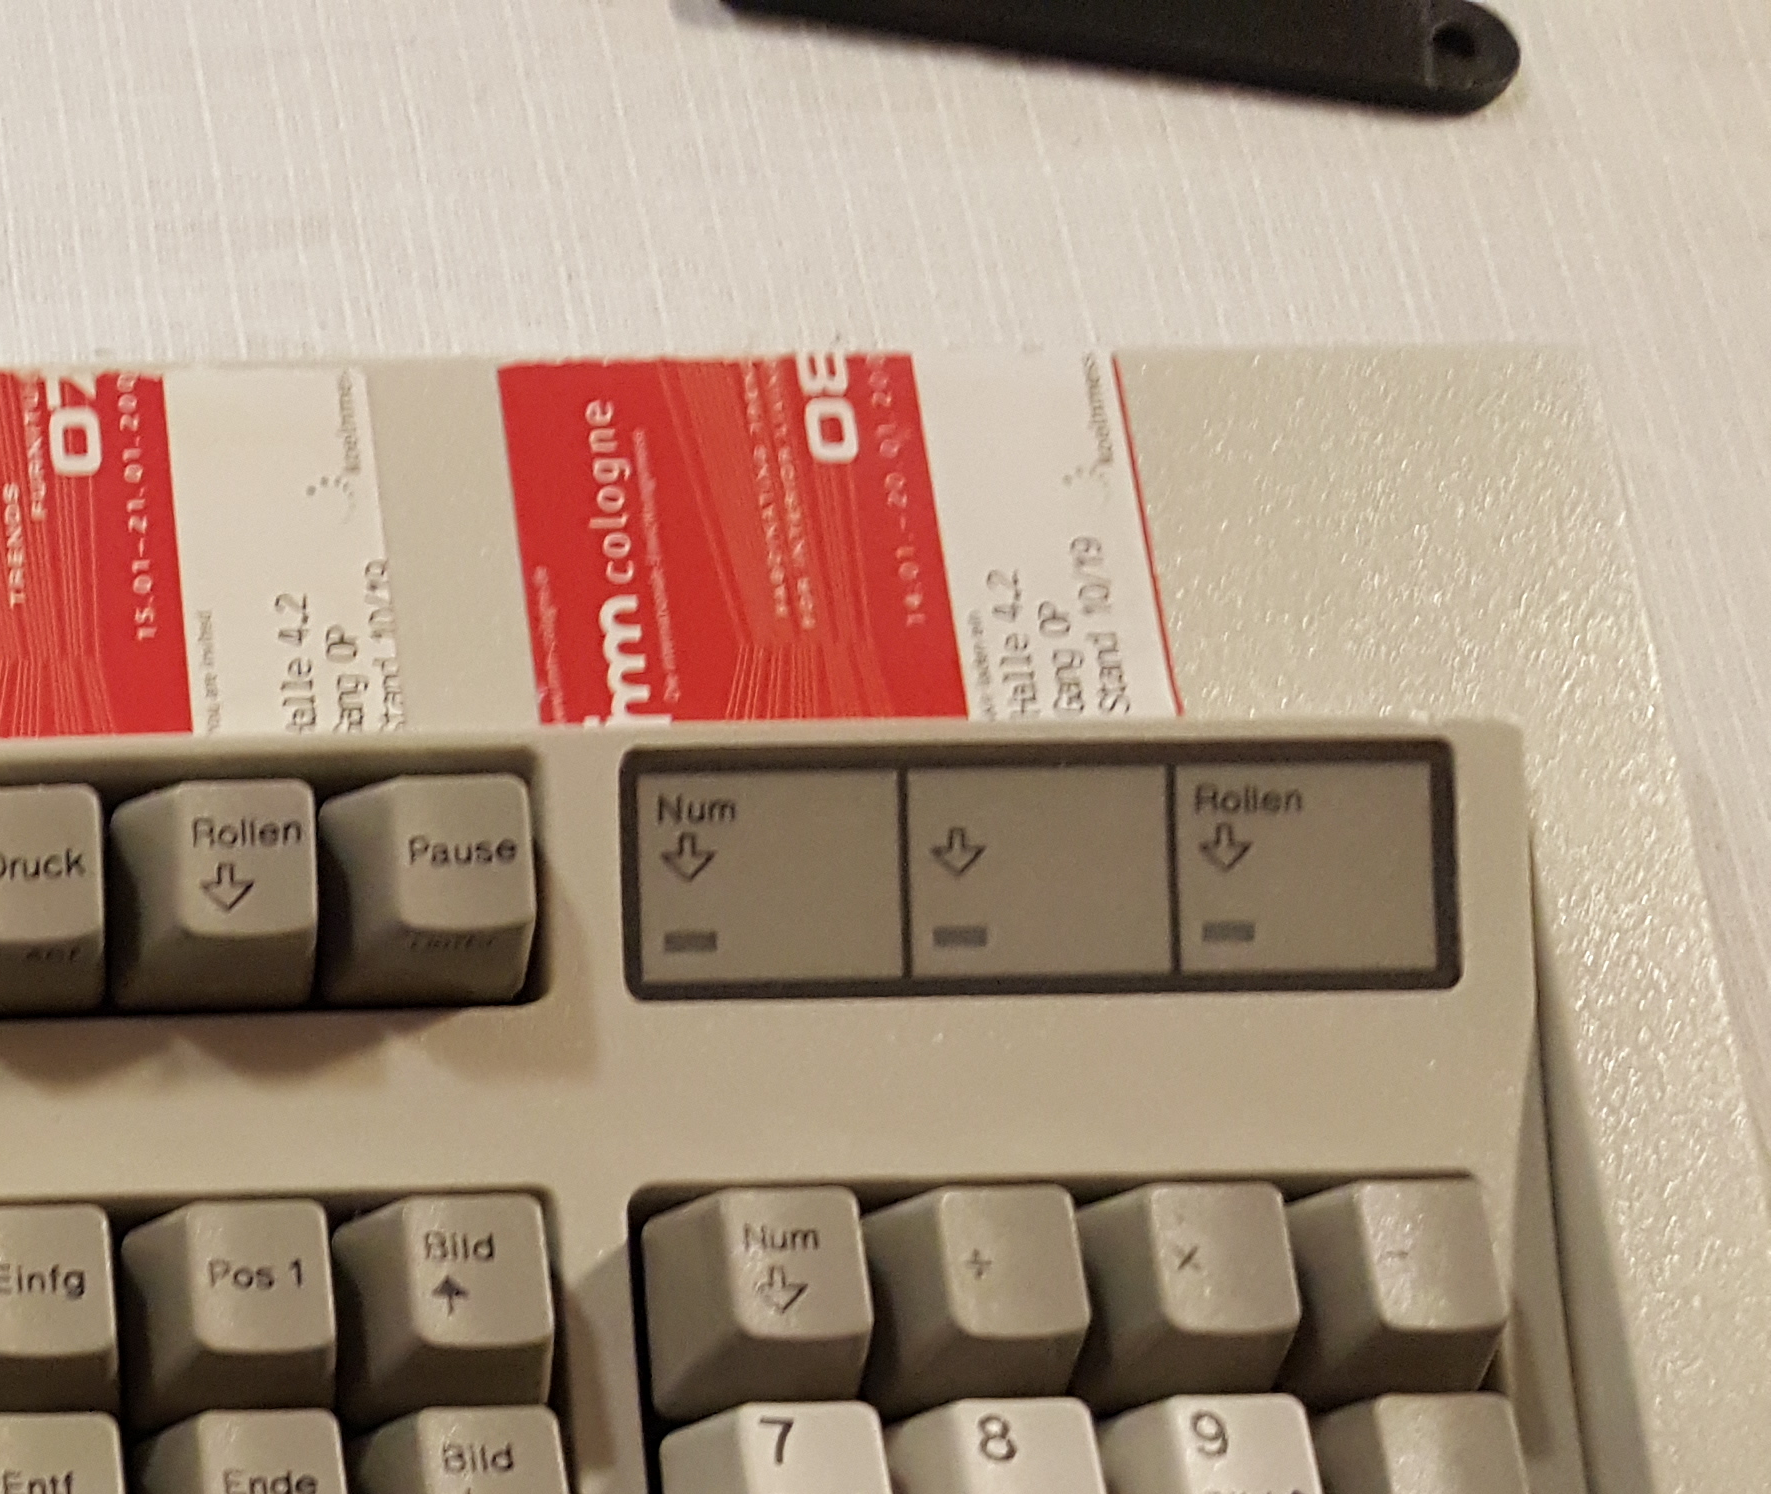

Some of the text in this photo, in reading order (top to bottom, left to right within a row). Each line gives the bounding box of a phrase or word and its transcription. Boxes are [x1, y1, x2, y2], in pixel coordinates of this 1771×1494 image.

[584, 399, 635, 584] cologne
[3, 482, 25, 608] TRENDS
[274, 592, 309, 647] 4.2
[986, 569, 1040, 716] Halle 4.2
[1070, 537, 1130, 713] Stand 10/19
[1050, 649, 1084, 712] Gang
[656, 793, 737, 826] Num
[1193, 782, 1304, 817] Rollen
[191, 817, 303, 850] Rollen
[408, 834, 518, 868] Pause
[423, 1231, 496, 1264] Bild
[741, 1222, 820, 1256] Num
[207, 1257, 304, 1291] Pos 1
[441, 1440, 516, 1475] Bild
[759, 1417, 795, 1465] 7
[977, 1412, 1018, 1464] 8
[1189, 1408, 1230, 1460] 9
